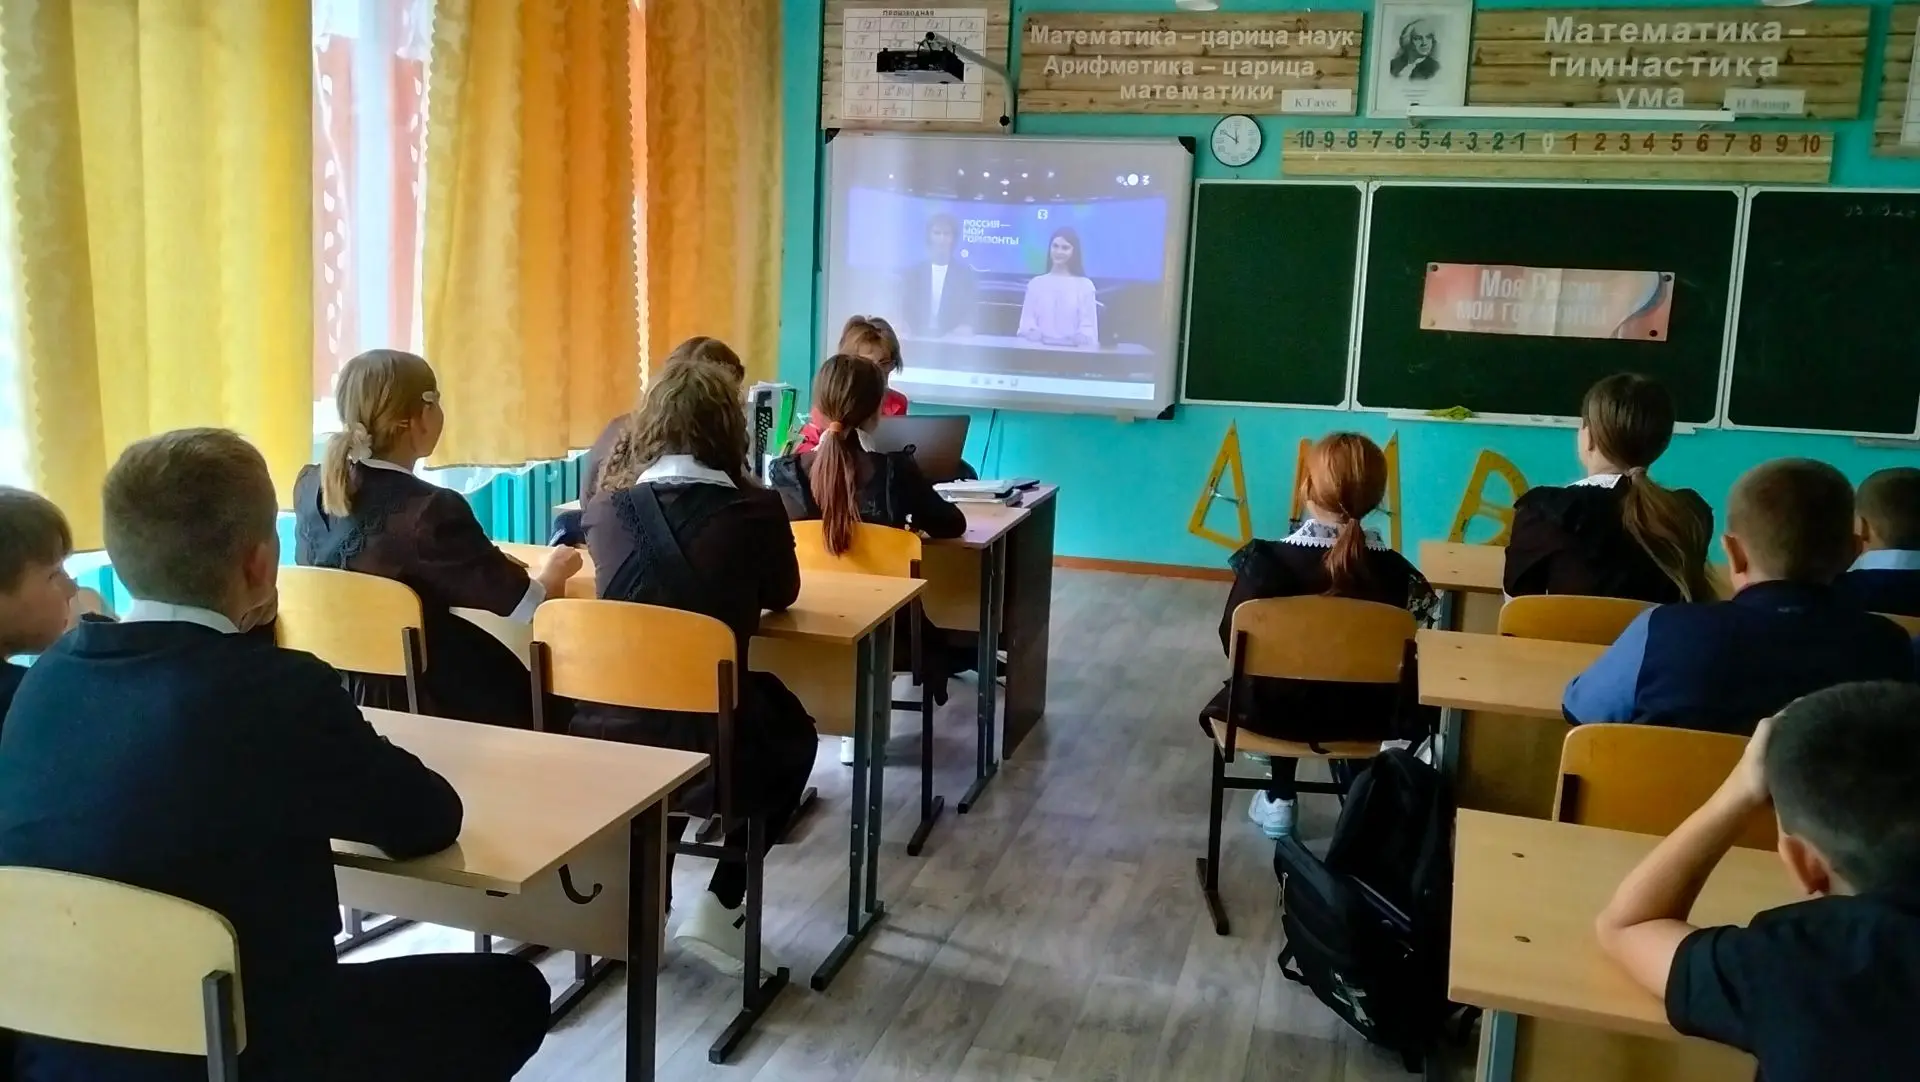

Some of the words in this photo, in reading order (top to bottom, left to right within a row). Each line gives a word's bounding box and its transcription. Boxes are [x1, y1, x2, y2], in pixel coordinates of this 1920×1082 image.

[1030, 25, 1177, 46] Математика
[1201, 29, 1289, 49] царица
[1299, 29, 1355, 49] наук
[1544, 16, 1783, 44] Математика
[1043, 54, 1195, 80] Арифметика
[1222, 59, 1315, 80] царица
[1549, 55, 1779, 78] гимнастика
[1120, 85, 1274, 101] математики
[1616, 86, 1685, 110] ума
[1542, 132, 1555, 150] 0
[1564, 133, 1578, 151] 1
[1594, 133, 1607, 151] 2
[1619, 133, 1631, 151] 3
[1643, 133, 1655, 151] 4
[1670, 133, 1683, 151] 5
[1696, 133, 1709, 152] 6
[1724, 133, 1736, 152] 7
[1749, 134, 1762, 153] 8
[1775, 134, 1788, 153] 9
[1798, 134, 1820, 153] 10
[1479, 269, 1525, 299] Моя
